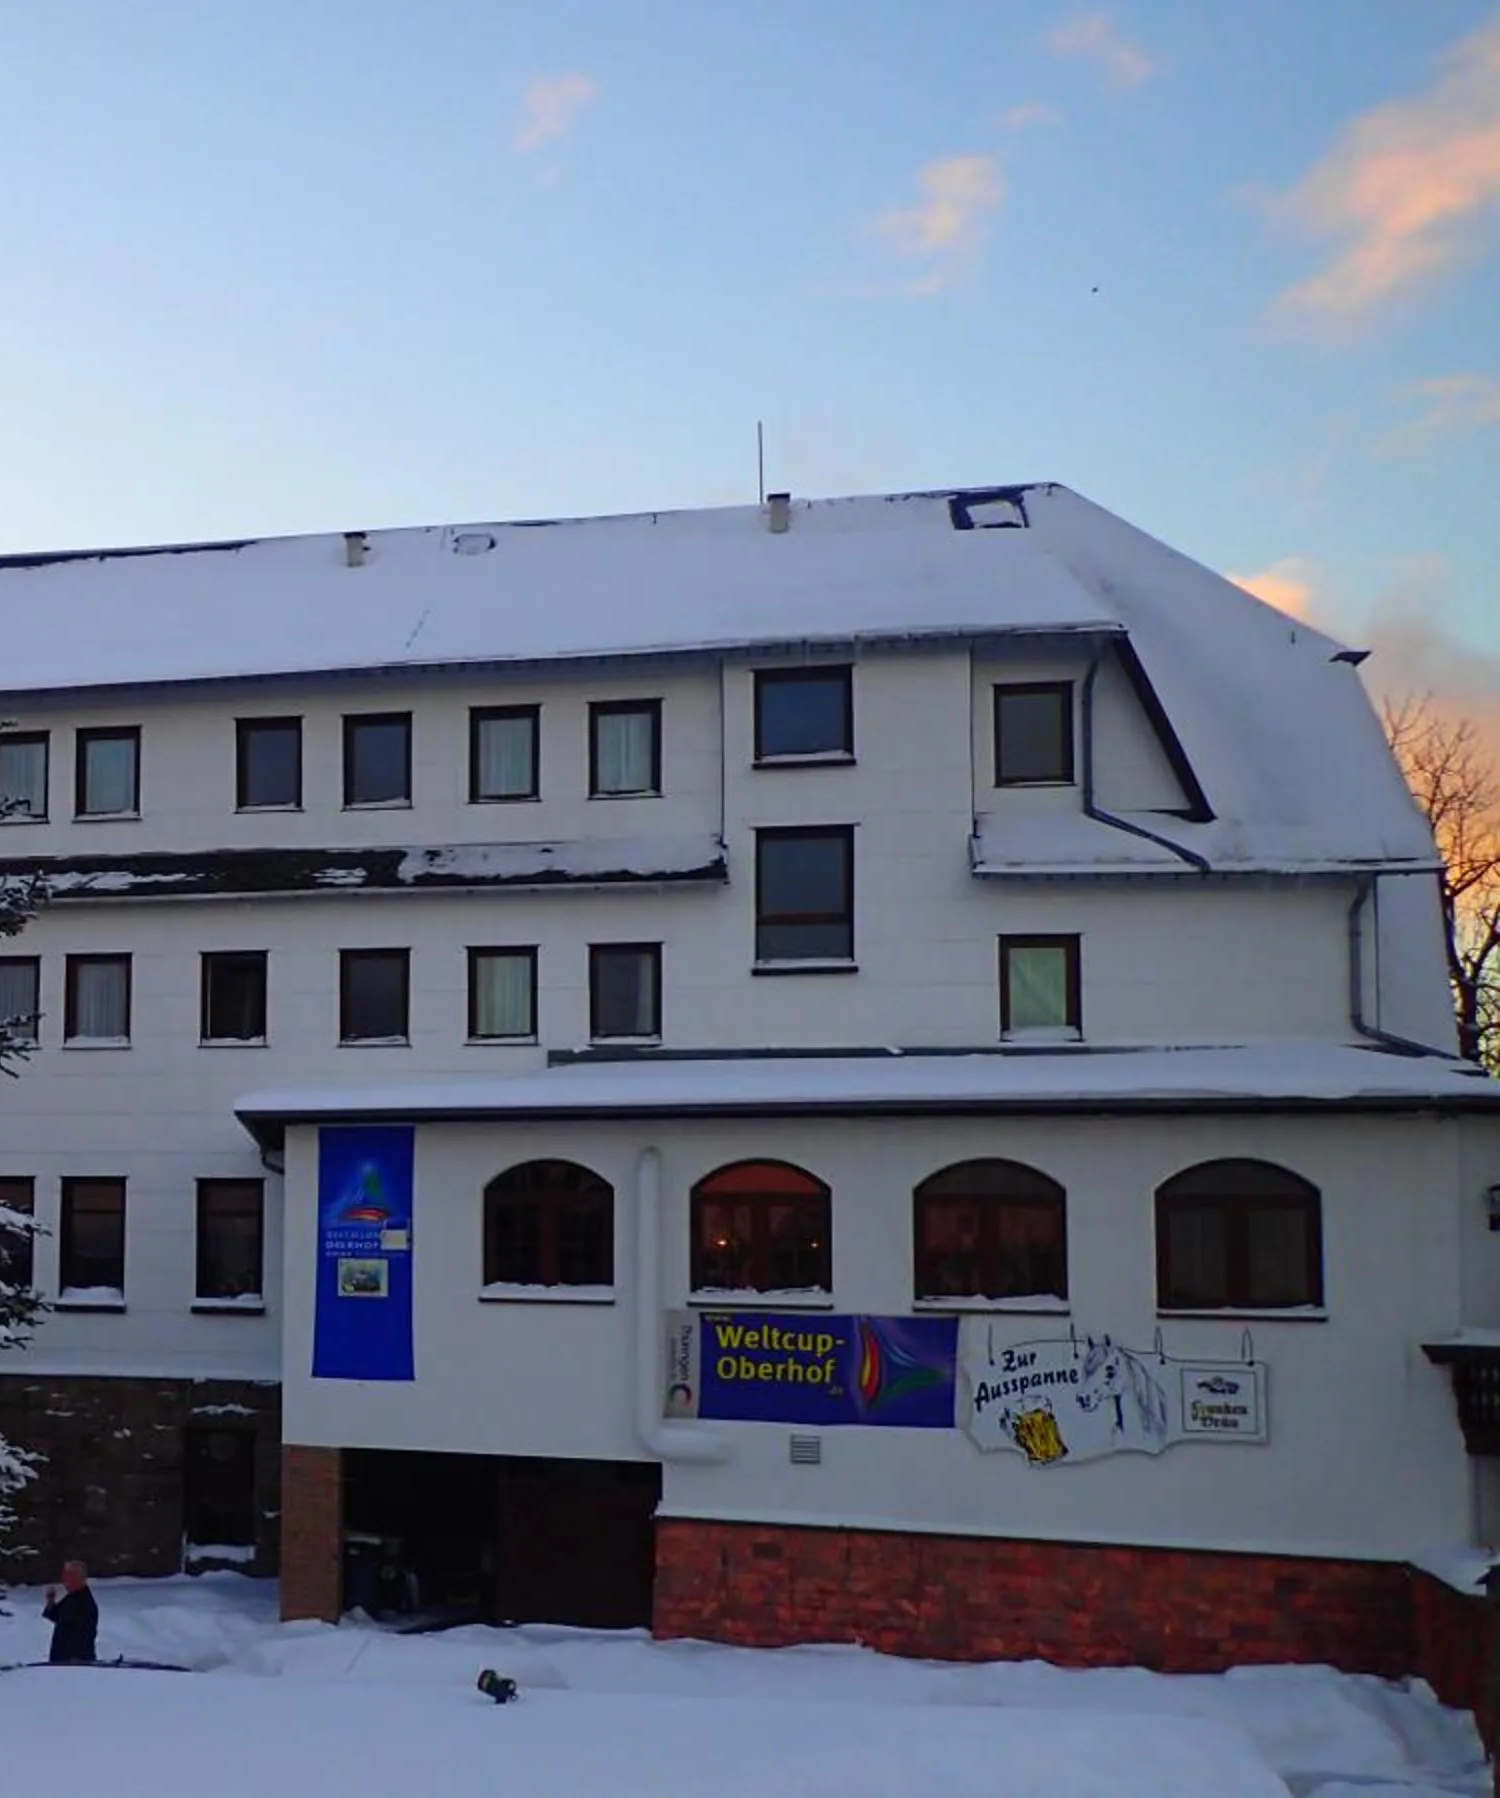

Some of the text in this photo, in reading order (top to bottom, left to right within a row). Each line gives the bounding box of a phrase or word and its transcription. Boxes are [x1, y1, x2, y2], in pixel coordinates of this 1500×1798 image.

[715, 1324, 846, 1357] Weltcup-
[715, 1356, 837, 1384] Oberhof
[1001, 1350, 1038, 1373] Zur
[974, 1368, 1080, 1412] Ausspanne
